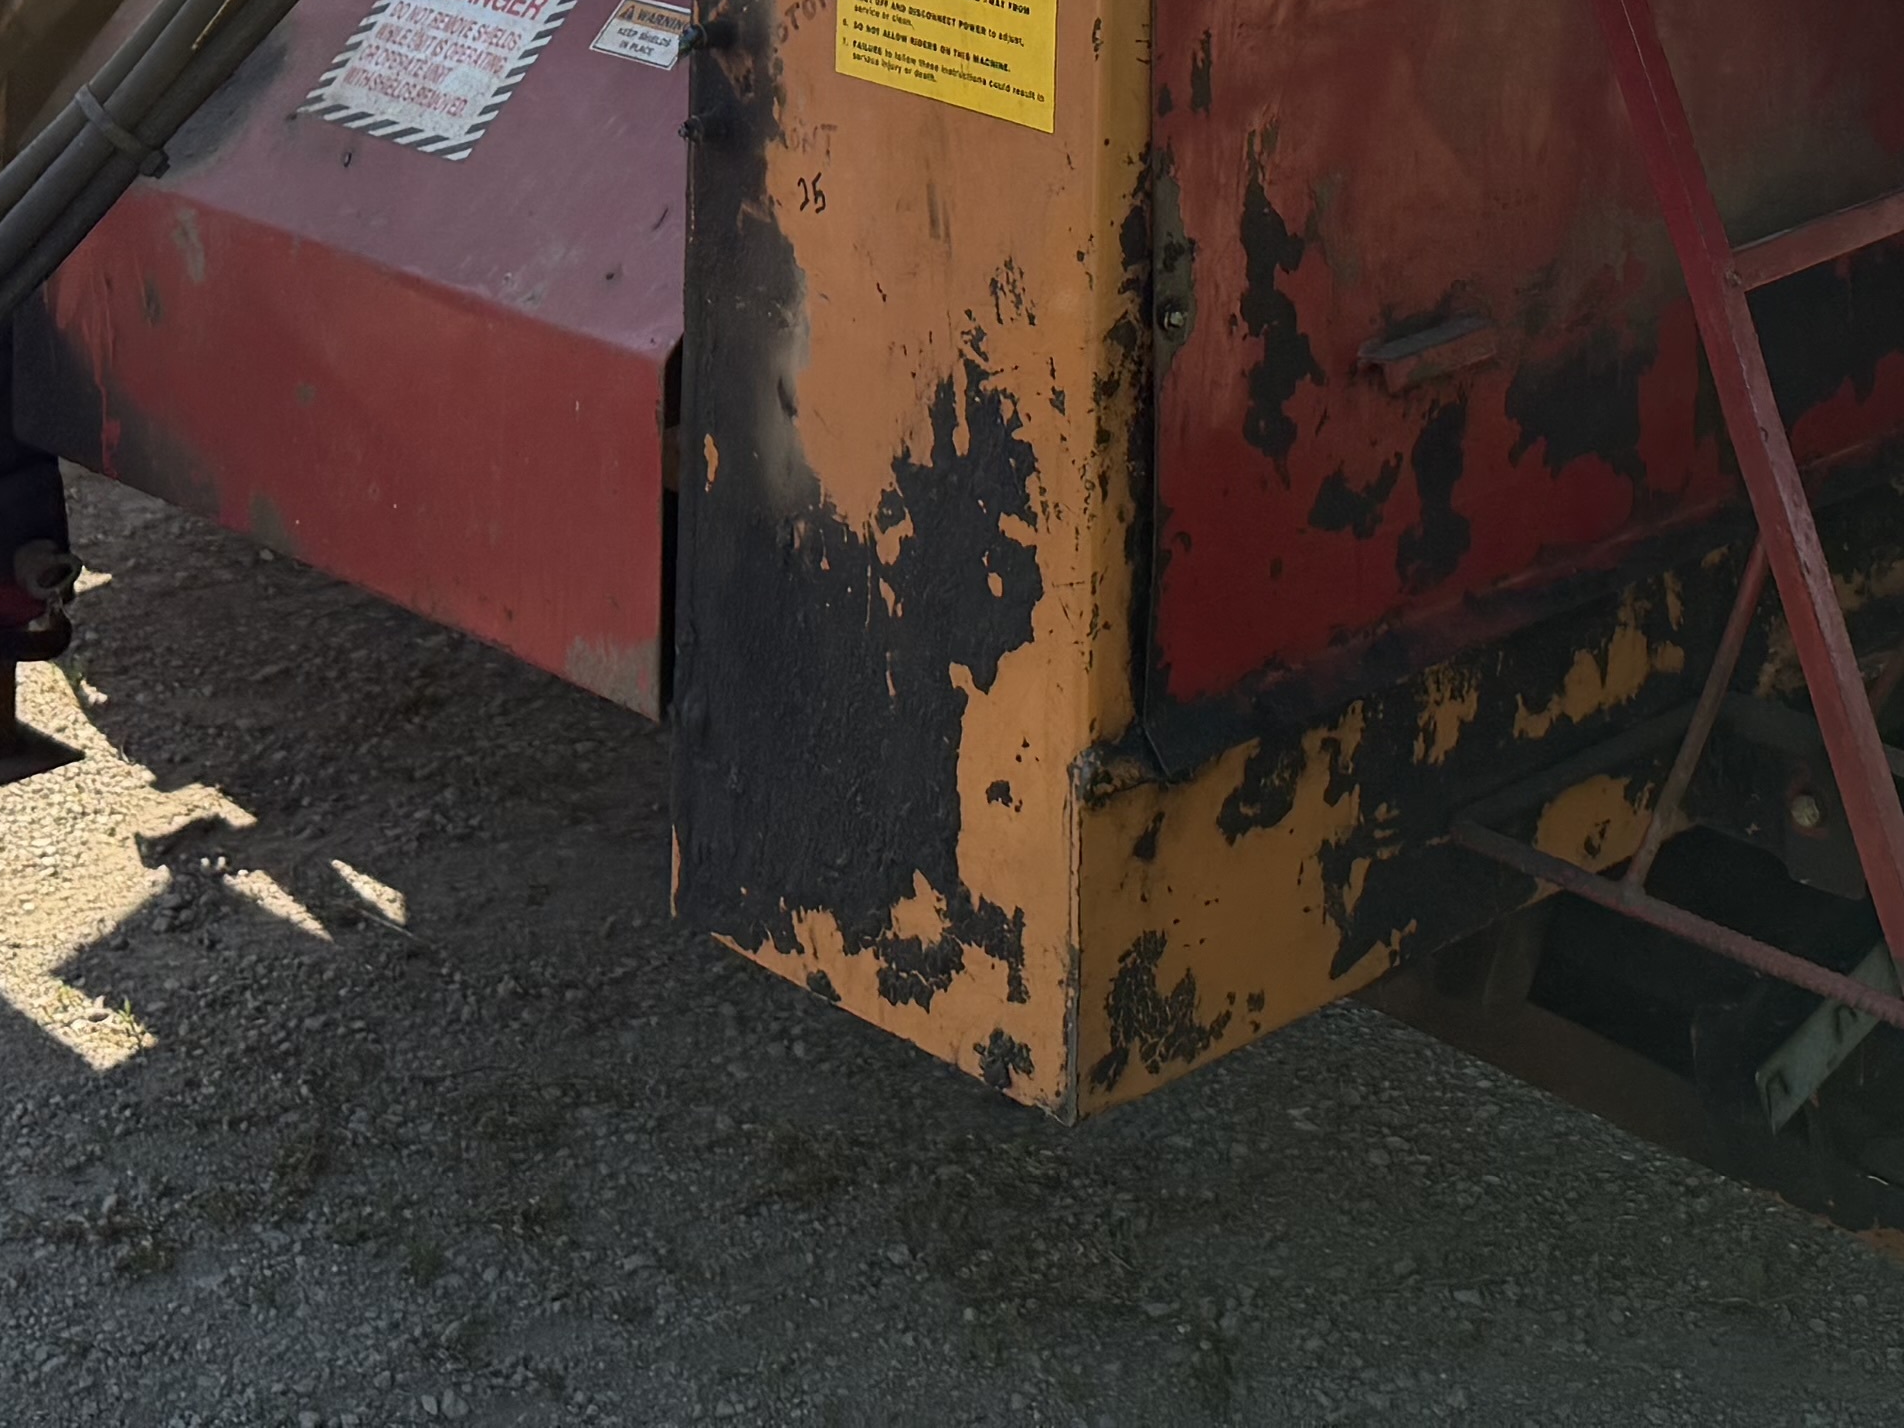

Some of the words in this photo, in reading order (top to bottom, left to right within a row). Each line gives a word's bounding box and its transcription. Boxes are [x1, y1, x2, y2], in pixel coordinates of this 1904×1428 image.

[390, 1, 410, 20] DO
[428, 11, 478, 39] REMOVE
[958, 18, 986, 34] POWER
